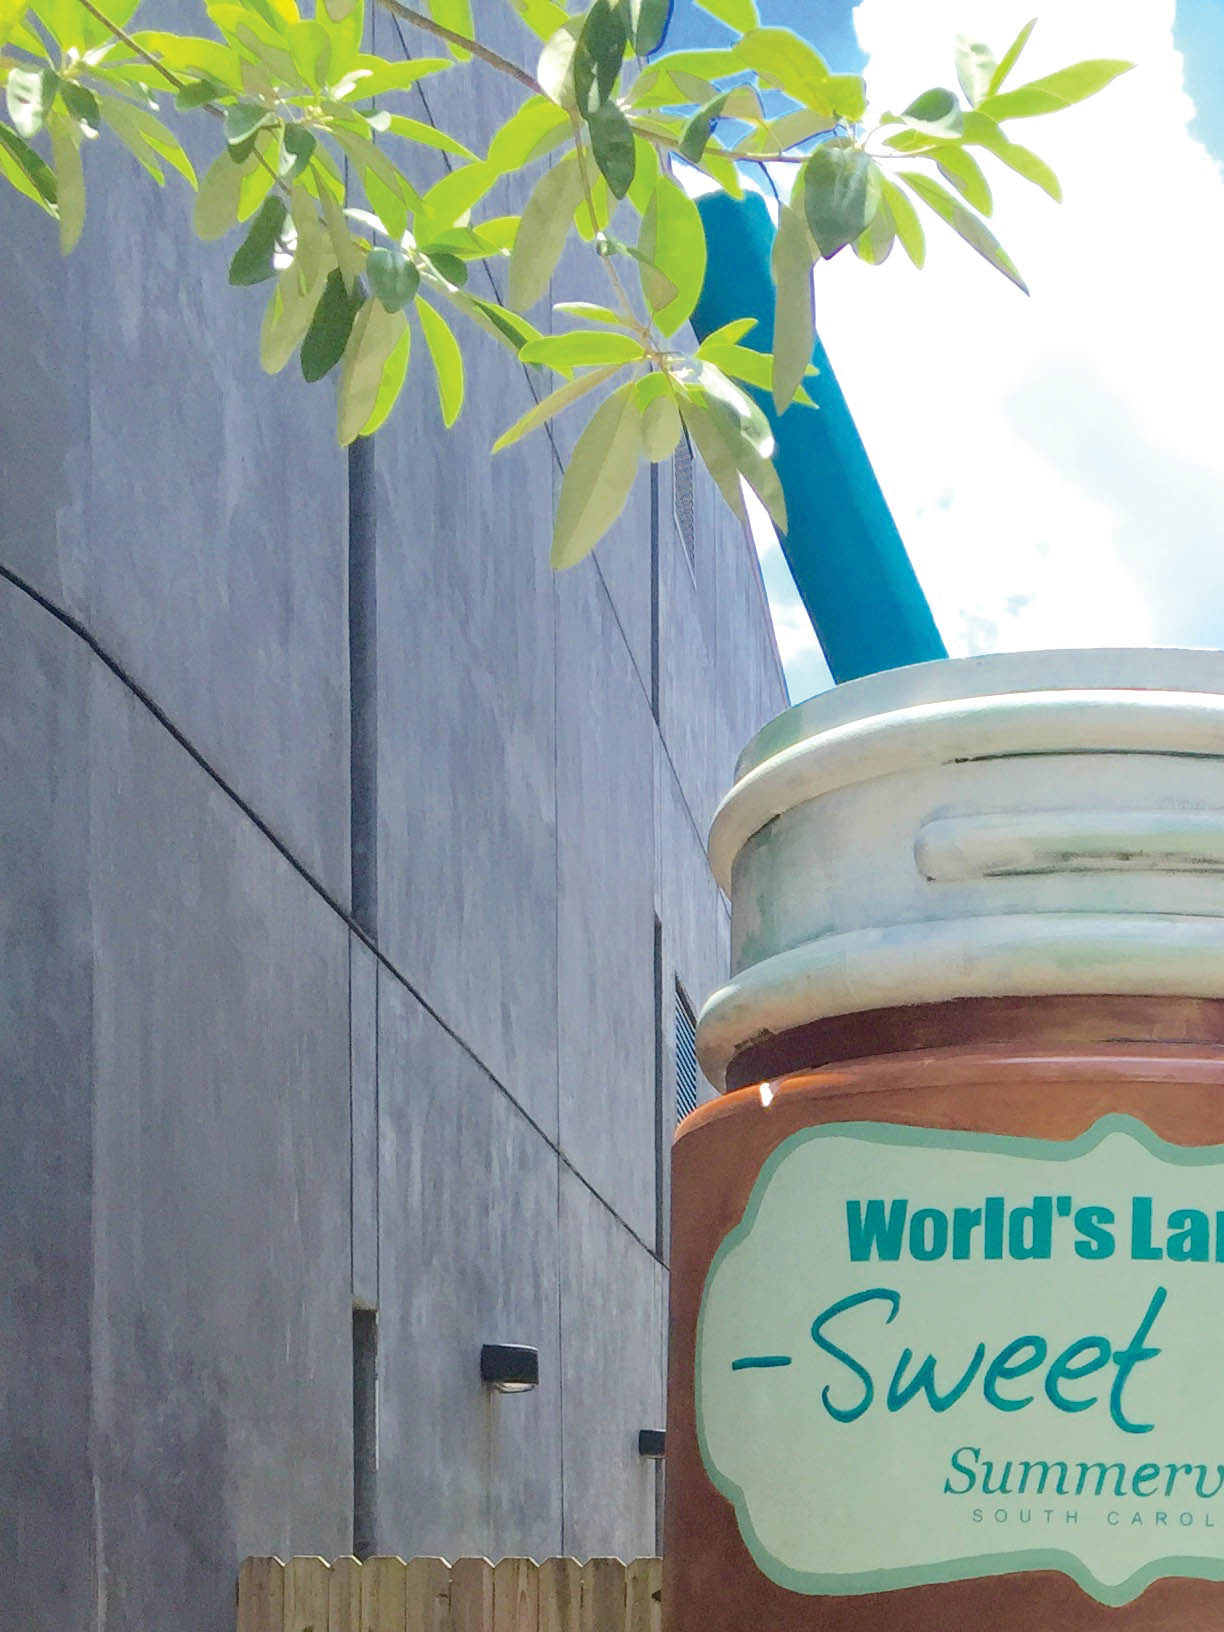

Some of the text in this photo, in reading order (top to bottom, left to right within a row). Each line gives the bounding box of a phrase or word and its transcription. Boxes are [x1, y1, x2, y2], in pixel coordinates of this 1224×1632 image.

[846, 1195, 1117, 1263] World's
[810, 1286, 1168, 1434] Sweet
[972, 1508, 1079, 1524] SOUTH
